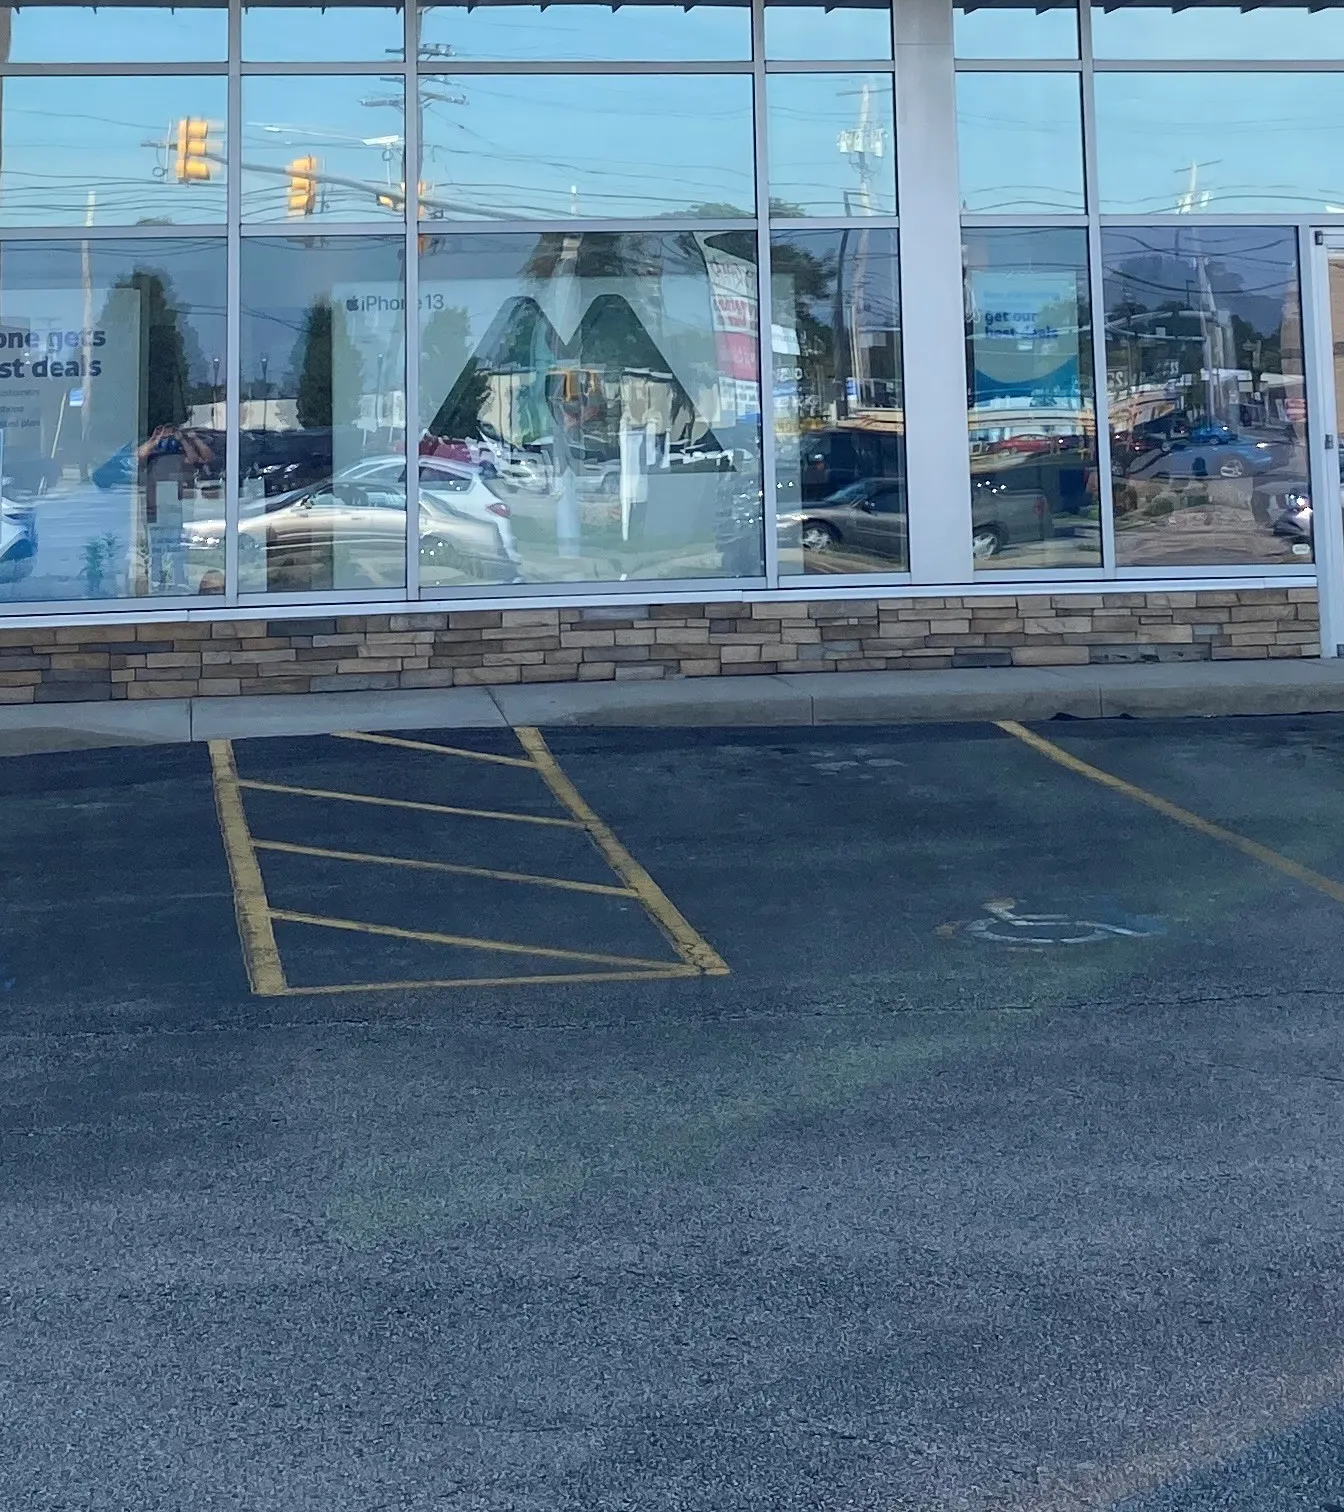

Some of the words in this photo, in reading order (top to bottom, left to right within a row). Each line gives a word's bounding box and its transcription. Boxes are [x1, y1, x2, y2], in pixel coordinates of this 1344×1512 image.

[425, 293, 445, 310] 13
[985, 311, 1010, 326] get
[1012, 312, 1037, 323] our
[32, 355, 102, 378] deals
